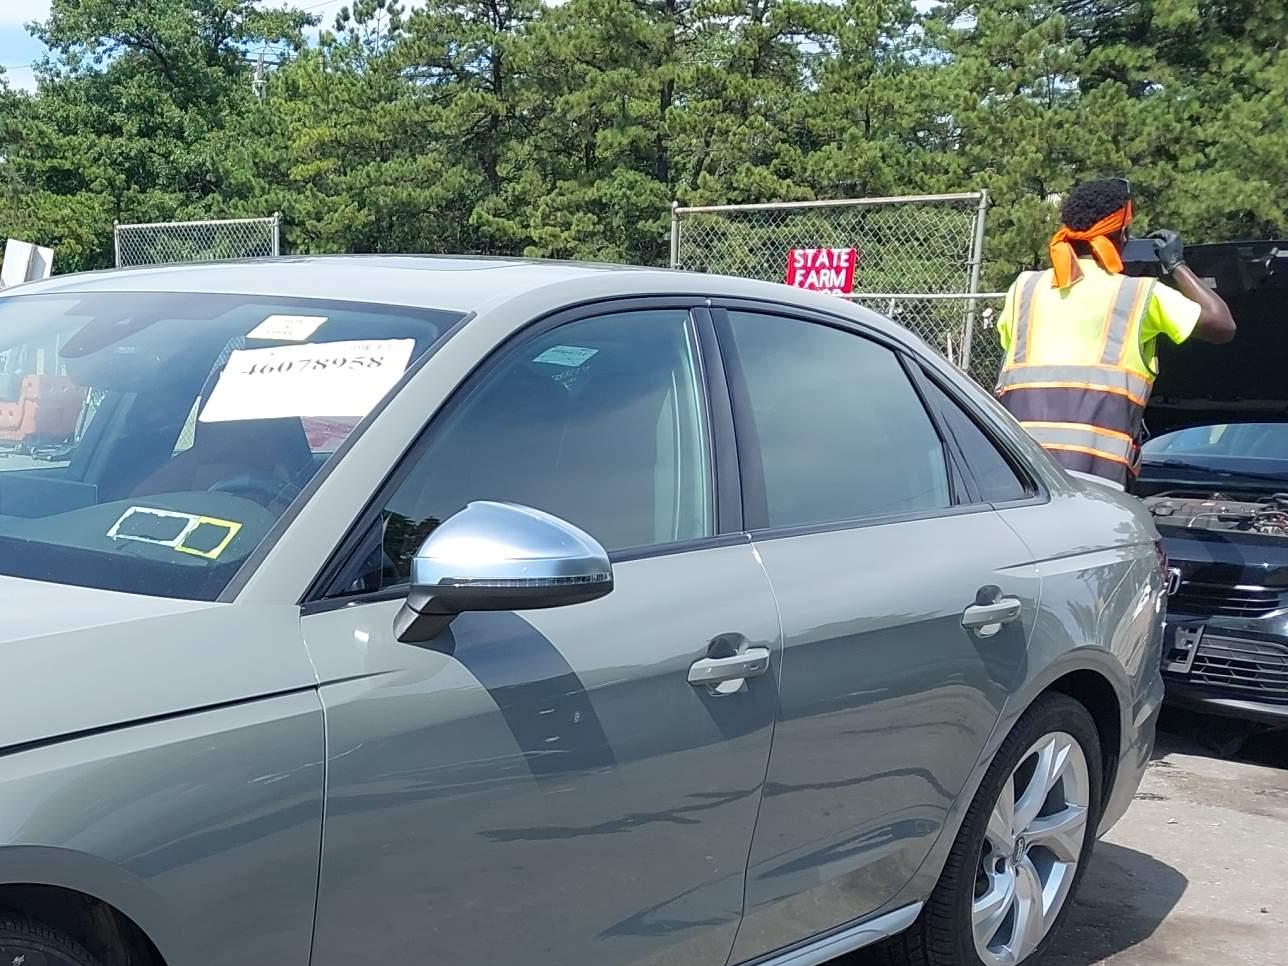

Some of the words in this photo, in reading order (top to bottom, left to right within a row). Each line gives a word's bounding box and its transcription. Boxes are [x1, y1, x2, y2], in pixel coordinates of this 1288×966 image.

[793, 248, 850, 268] STATE
[795, 268, 847, 288] FARM
[241, 356, 384, 376] 46078958
